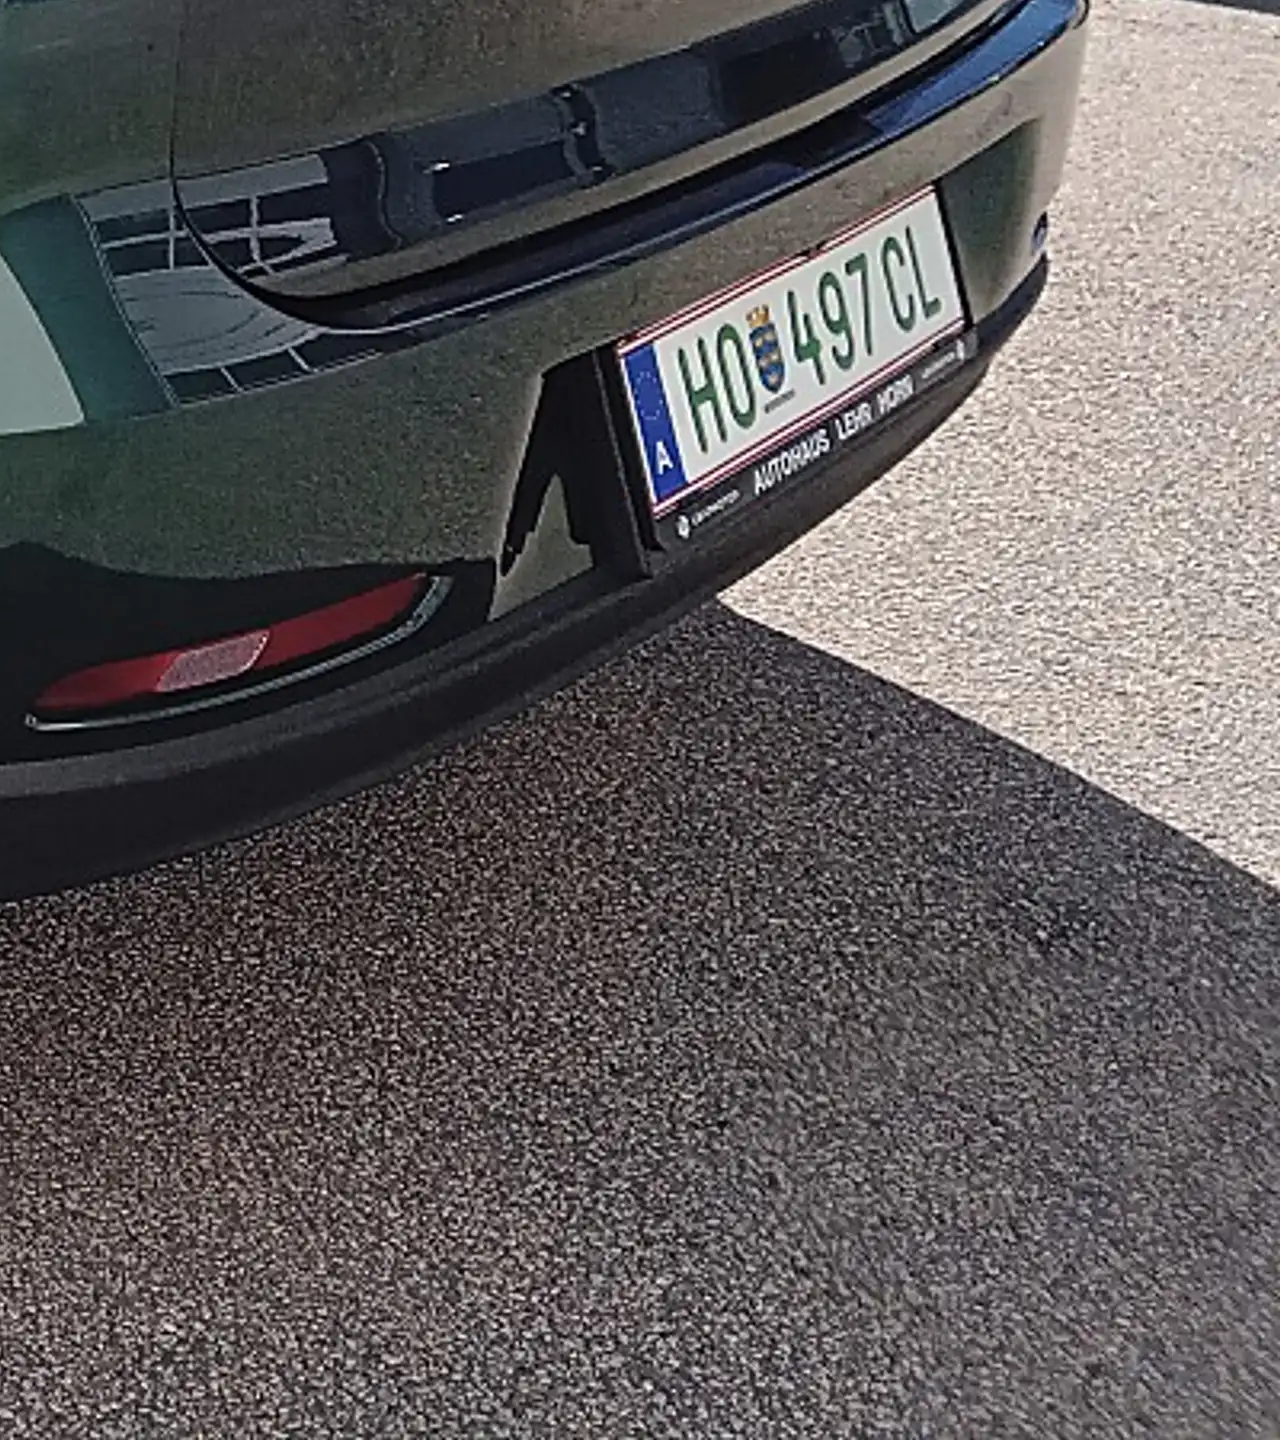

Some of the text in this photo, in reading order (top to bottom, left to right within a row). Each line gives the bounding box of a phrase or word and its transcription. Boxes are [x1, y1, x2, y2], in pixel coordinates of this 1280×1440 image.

[676, 224, 942, 455] HO 497 CL
[652, 441, 674, 476] A
[753, 427, 830, 497] AUTOHAUS
[834, 401, 873, 440] LEHR
